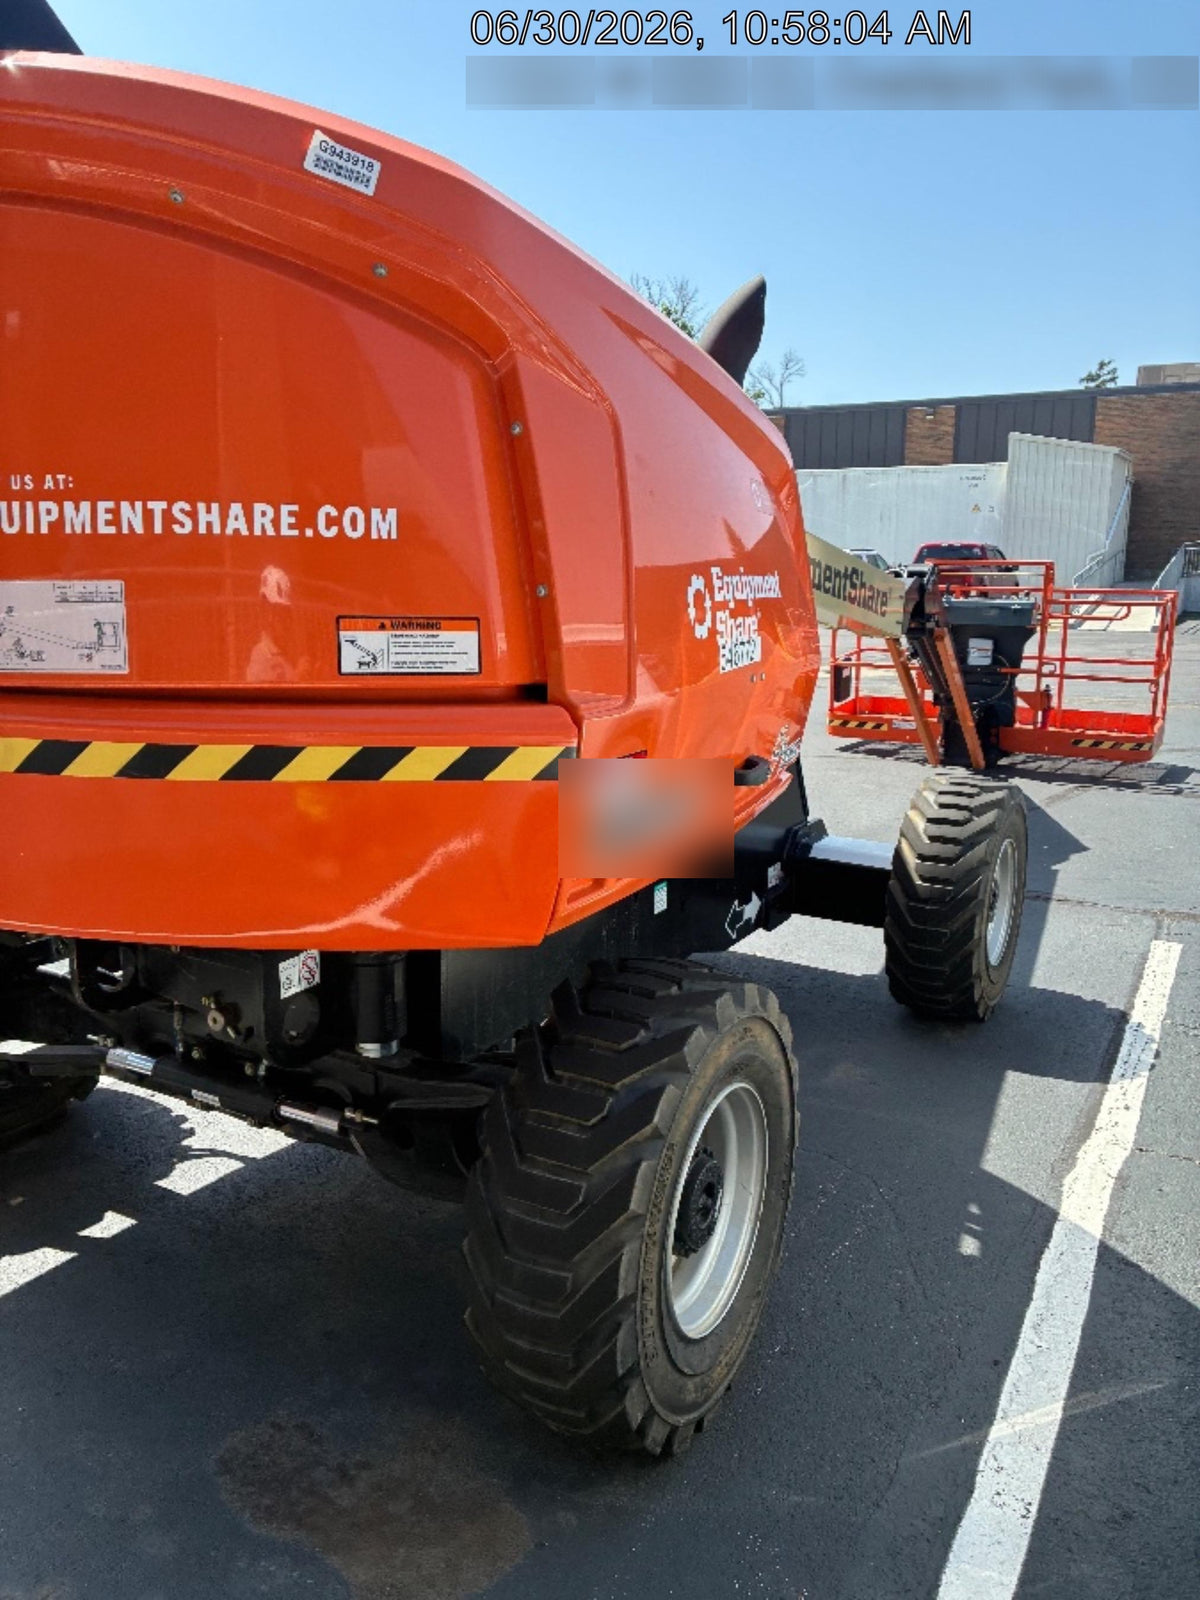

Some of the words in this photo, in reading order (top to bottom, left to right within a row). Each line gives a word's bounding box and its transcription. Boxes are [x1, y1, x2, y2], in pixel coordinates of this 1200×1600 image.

[10, 474, 34, 490] US
[44, 474, 74, 490] AT:
[711, 566, 782, 608] Equipment
[391, 620, 442, 630] WARNING
[716, 609, 759, 645] Share
